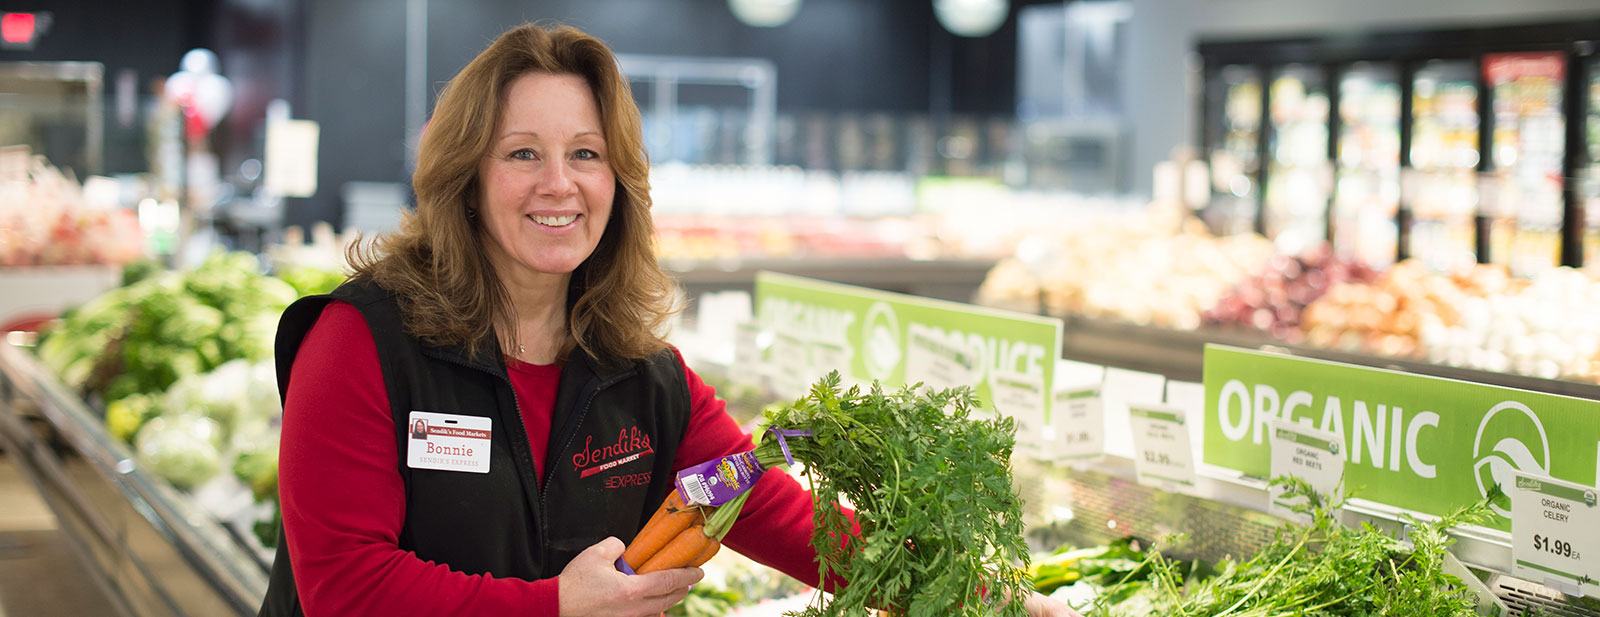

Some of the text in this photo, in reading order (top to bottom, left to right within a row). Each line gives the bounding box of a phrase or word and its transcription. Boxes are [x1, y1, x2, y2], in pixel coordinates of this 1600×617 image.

[1218, 379, 1441, 478] ORGANIC
[426, 441, 473, 457] Bonnie
[1296, 447, 1319, 459] ORGANIC
[599, 454, 640, 471] FOOD MARKET
[1292, 457, 1322, 470] RED BEETS
[605, 472, 652, 488] EXPRESS
[1541, 498, 1571, 513] ORGANIC
[1543, 510, 1569, 523] CELERY
[1533, 534, 1581, 560] $1.99 EA
